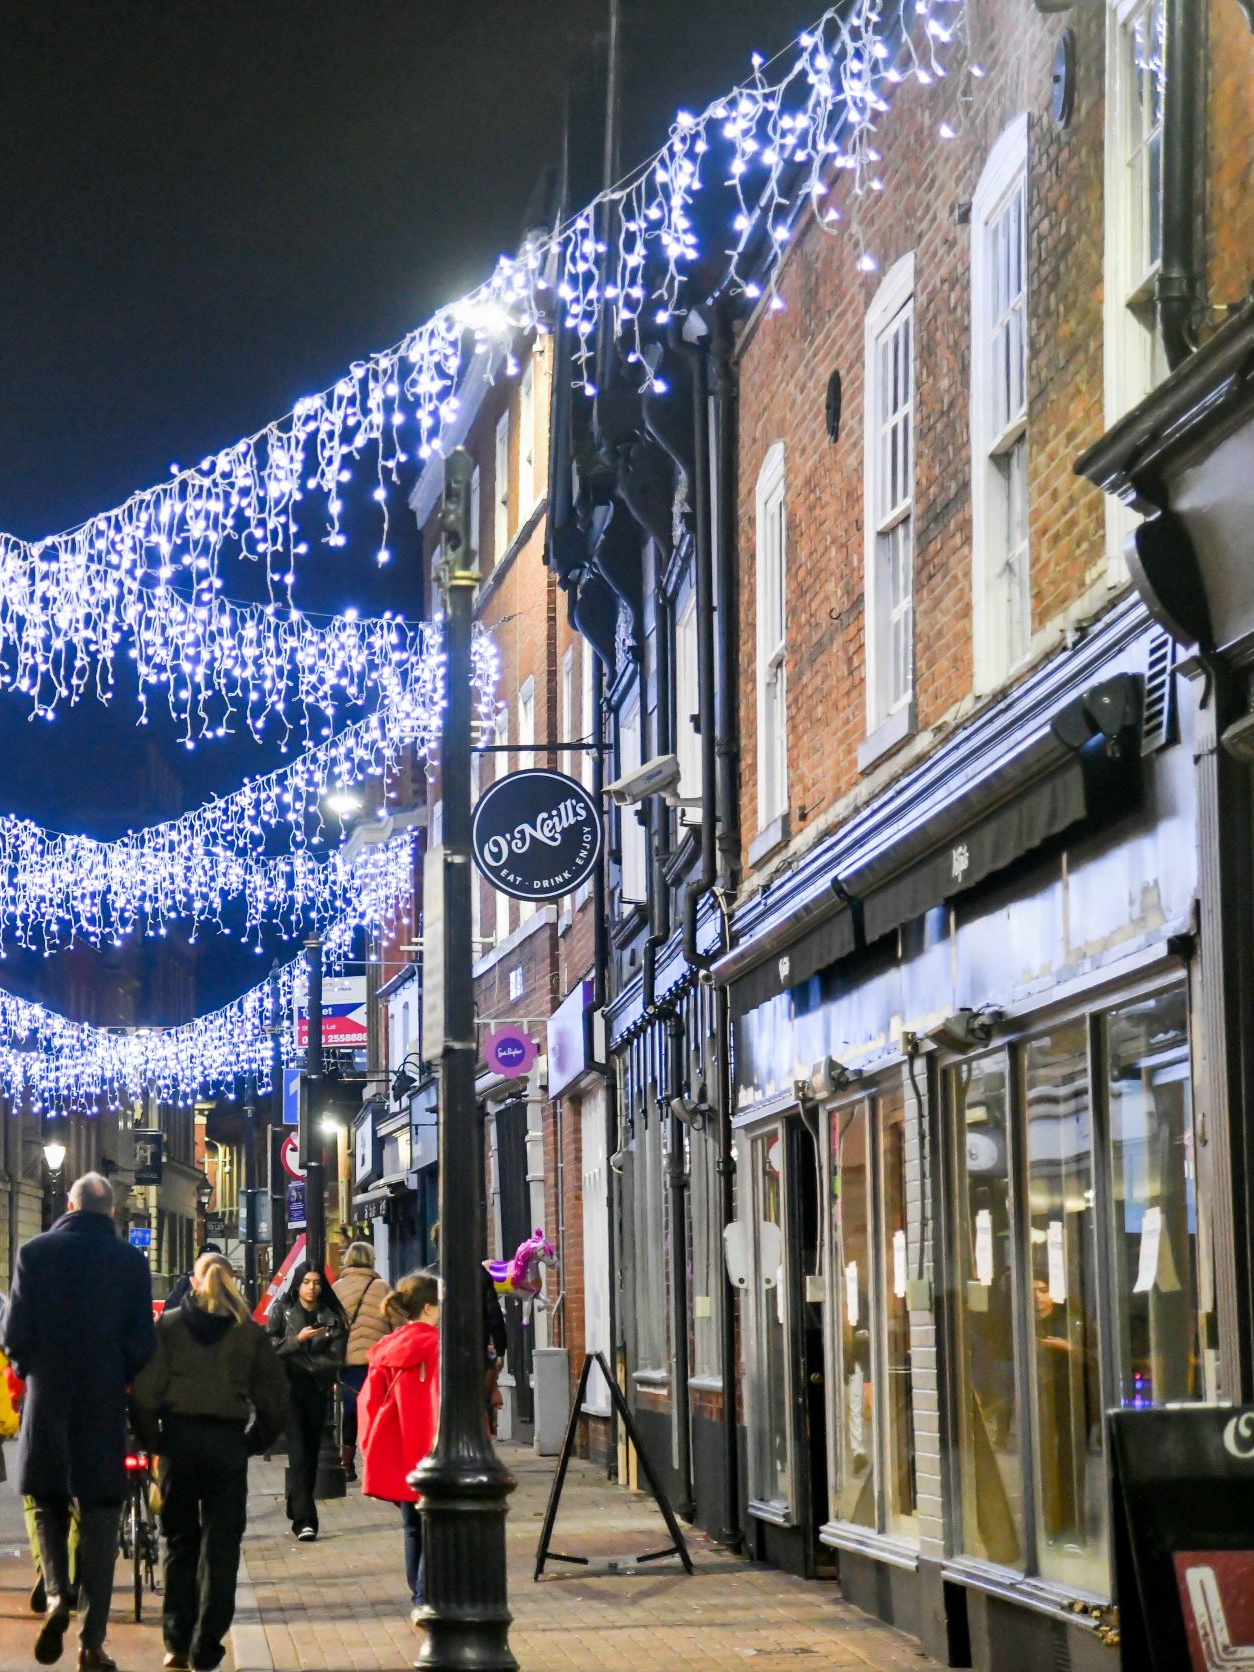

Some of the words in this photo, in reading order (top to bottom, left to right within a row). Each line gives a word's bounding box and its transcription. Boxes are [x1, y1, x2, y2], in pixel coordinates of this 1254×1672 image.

[483, 798, 587, 867] O'Neill's
[500, 868, 523, 885] EAT
[534, 871, 572, 889] DRINK
[575, 826, 592, 866] ENJOY
